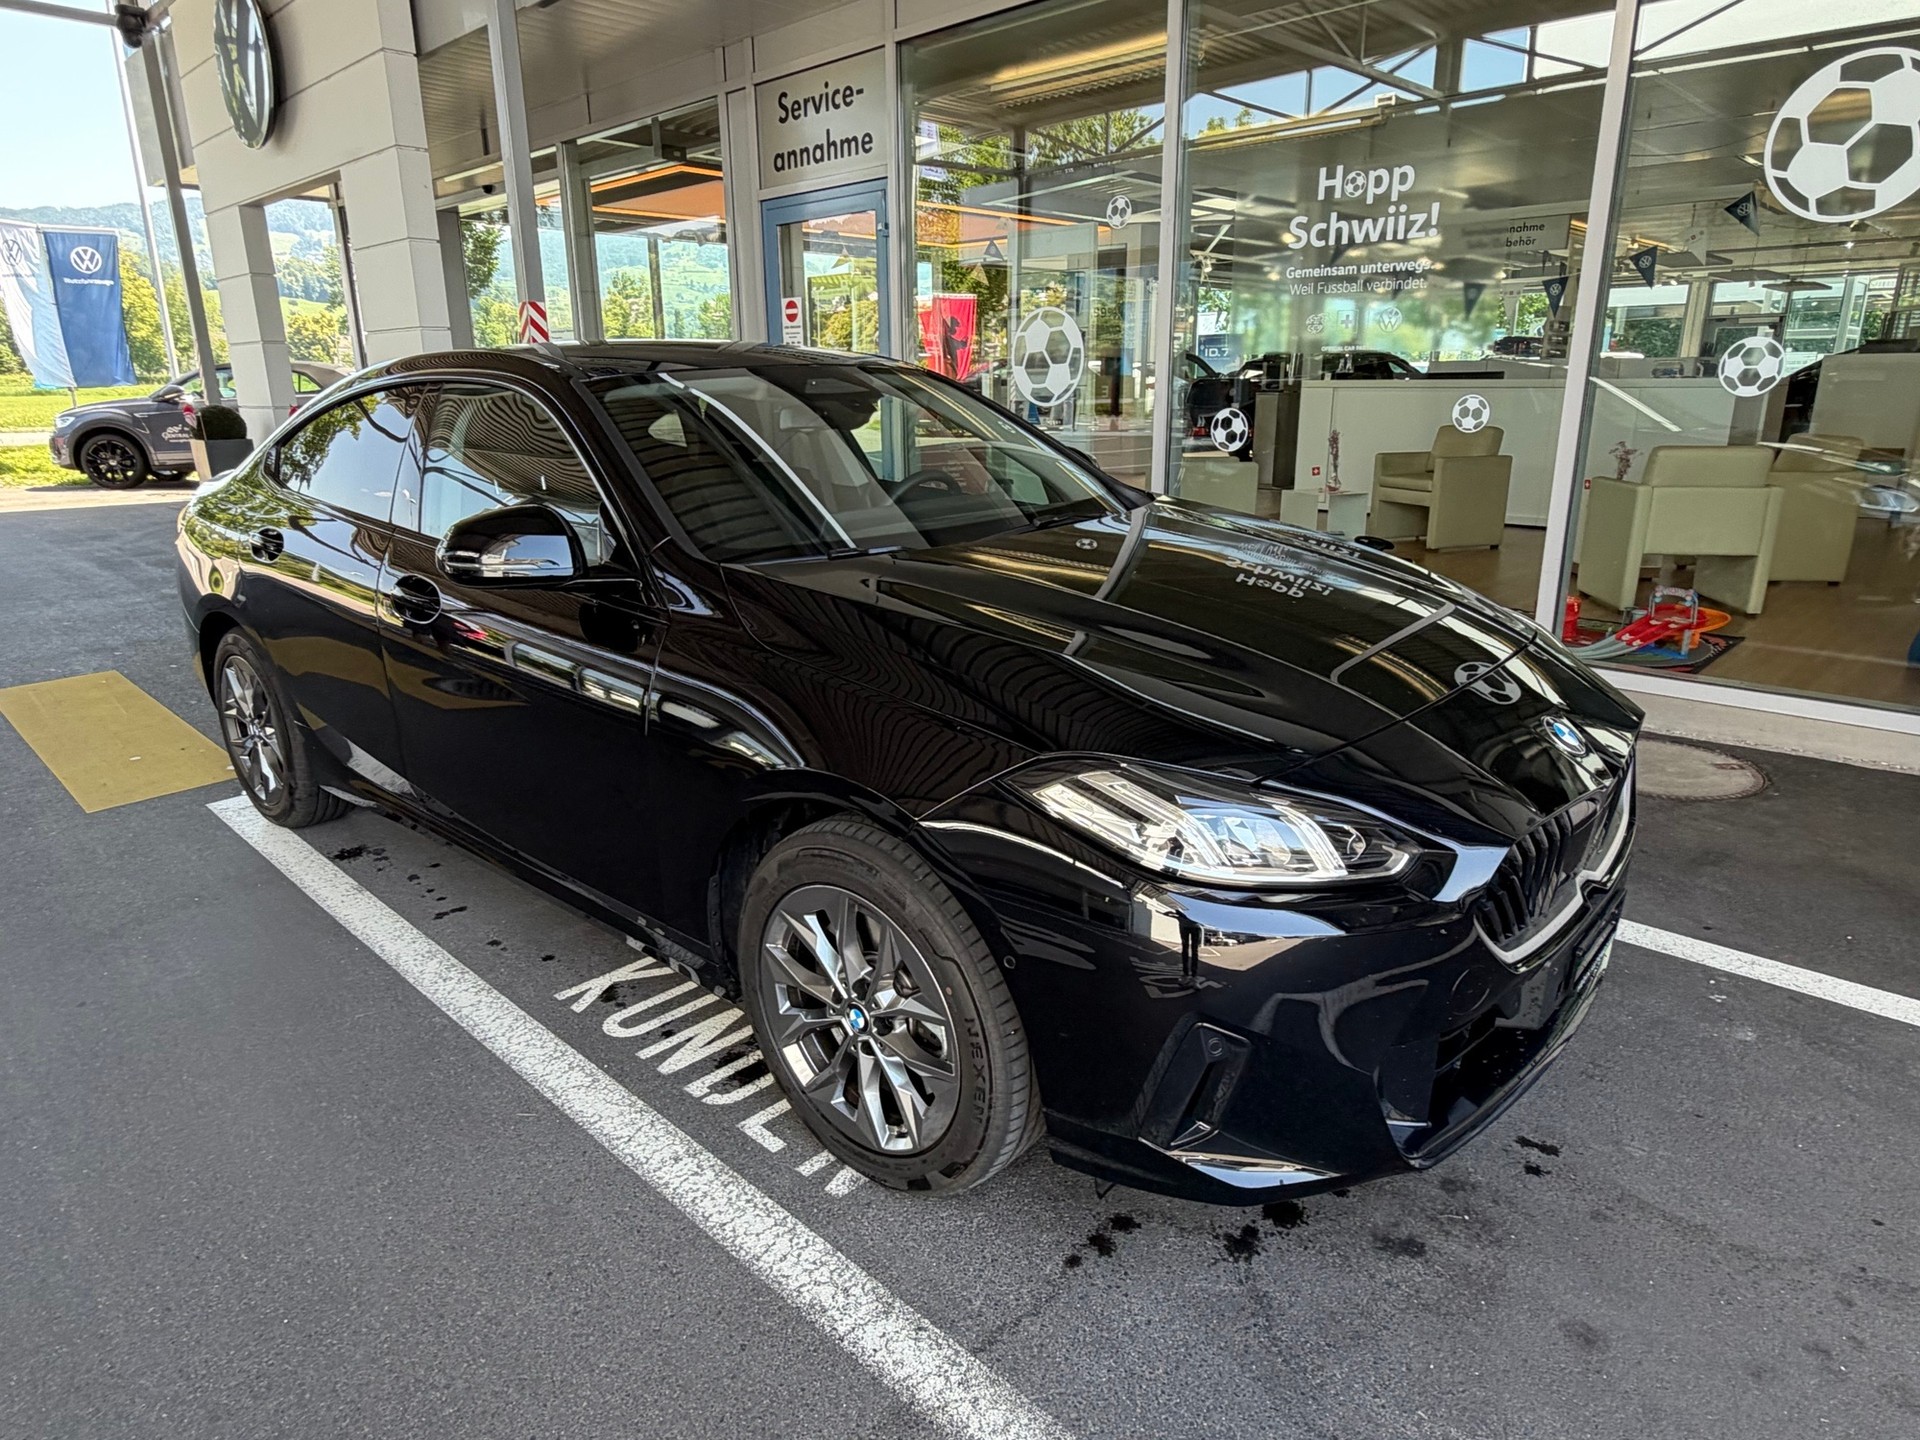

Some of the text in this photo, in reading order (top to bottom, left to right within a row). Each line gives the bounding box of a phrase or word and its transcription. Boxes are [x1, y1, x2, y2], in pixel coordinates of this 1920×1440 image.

[778, 81, 864, 124] Service-
[773, 128, 873, 172] annahme
[1317, 164, 1416, 204] Hopp
[1287, 202, 1440, 249] Schwiiz!
[1286, 264, 1357, 279] Gemeinsam
[1289, 282, 1314, 296] Weil
[1317, 279, 1364, 294] Fussball
[964, 1018, 986, 1124] NEXEN
